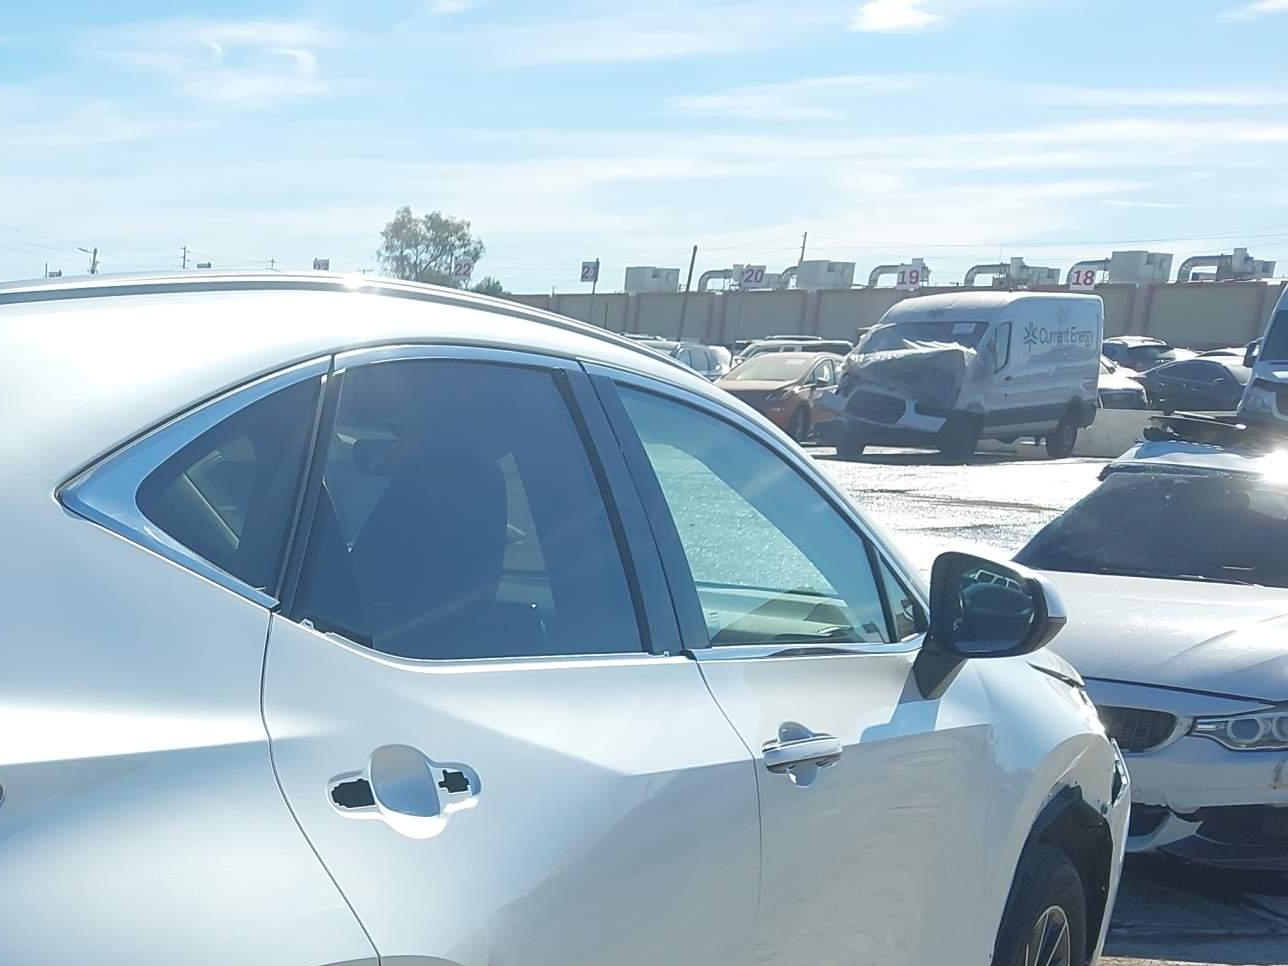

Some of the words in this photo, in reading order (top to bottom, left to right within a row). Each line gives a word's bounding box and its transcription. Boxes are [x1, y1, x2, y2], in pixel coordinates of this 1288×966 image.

[455, 262, 472, 276] 22
[743, 268, 764, 283] 20
[896, 269, 920, 285] 19
[1072, 269, 1095, 286] 18
